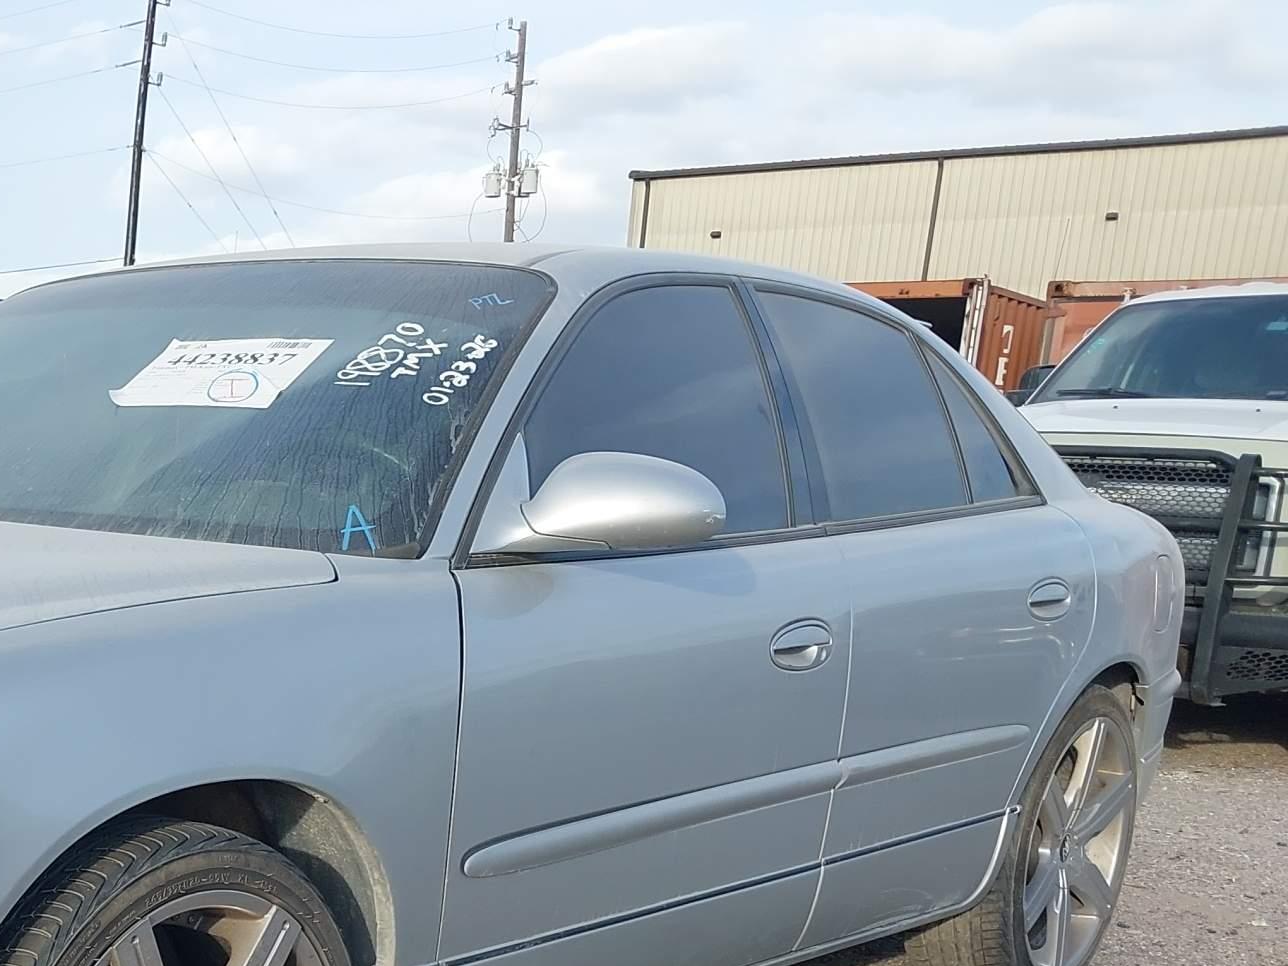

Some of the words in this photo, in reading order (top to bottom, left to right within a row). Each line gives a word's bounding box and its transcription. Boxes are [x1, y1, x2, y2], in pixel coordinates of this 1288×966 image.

[167, 352, 299, 366] 44238837
[390, 338, 449, 380] TMX
[340, 505, 377, 556] A
